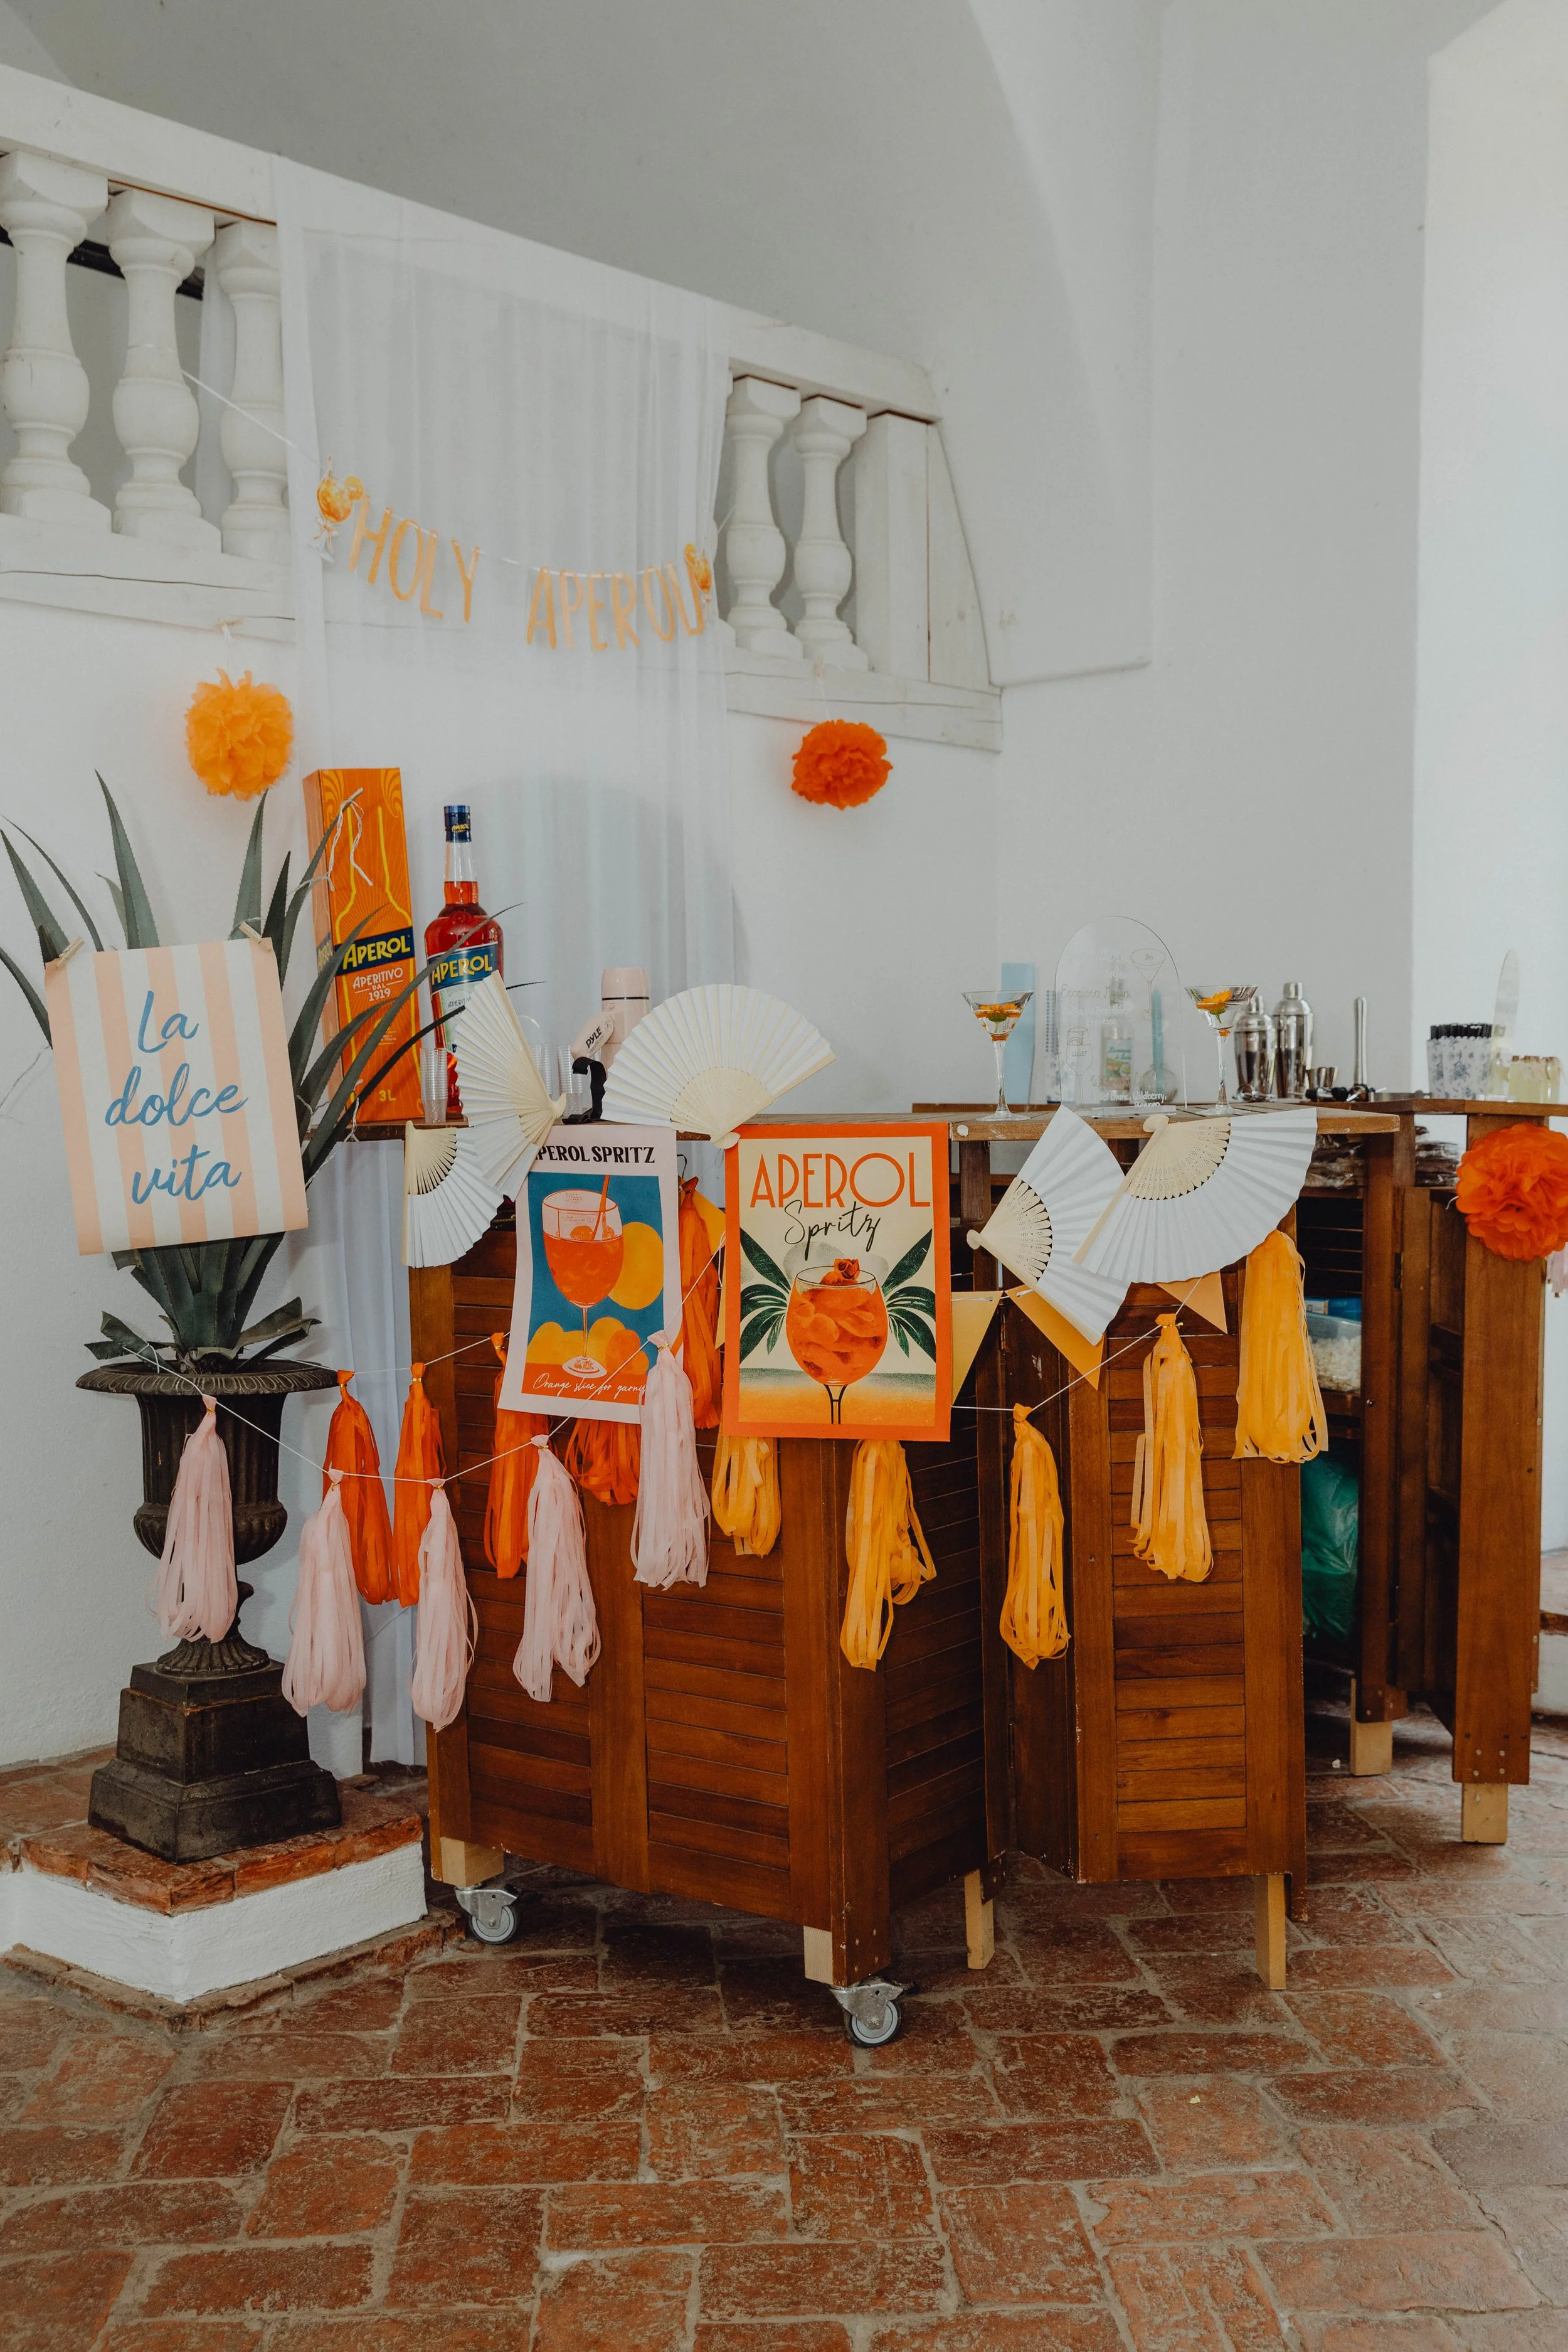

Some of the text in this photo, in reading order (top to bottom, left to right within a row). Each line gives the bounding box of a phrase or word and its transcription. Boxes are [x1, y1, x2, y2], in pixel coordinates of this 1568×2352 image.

[348, 494, 480, 623] HOLY
[343, 935, 411, 971] APEROL
[352, 967, 403, 990] APERITIVO
[432, 954, 492, 985] APEROL
[369, 987, 391, 1002] 1919
[372, 983, 386, 991] DAL
[448, 996, 471, 1008] APERITIV
[138, 991, 199, 1053] La
[585, 1026, 602, 1049] PYLE
[105, 1063, 248, 1127] dolce
[379, 1089, 396, 1102] 3L
[536, 1146, 655, 1163] PEROL SPRITZ
[132, 1144, 242, 1205] vita
[750, 1152, 931, 1208] APEROL
[784, 1200, 881, 1261] Spritz
[533, 1372, 647, 1400] Orange slice for garnis
